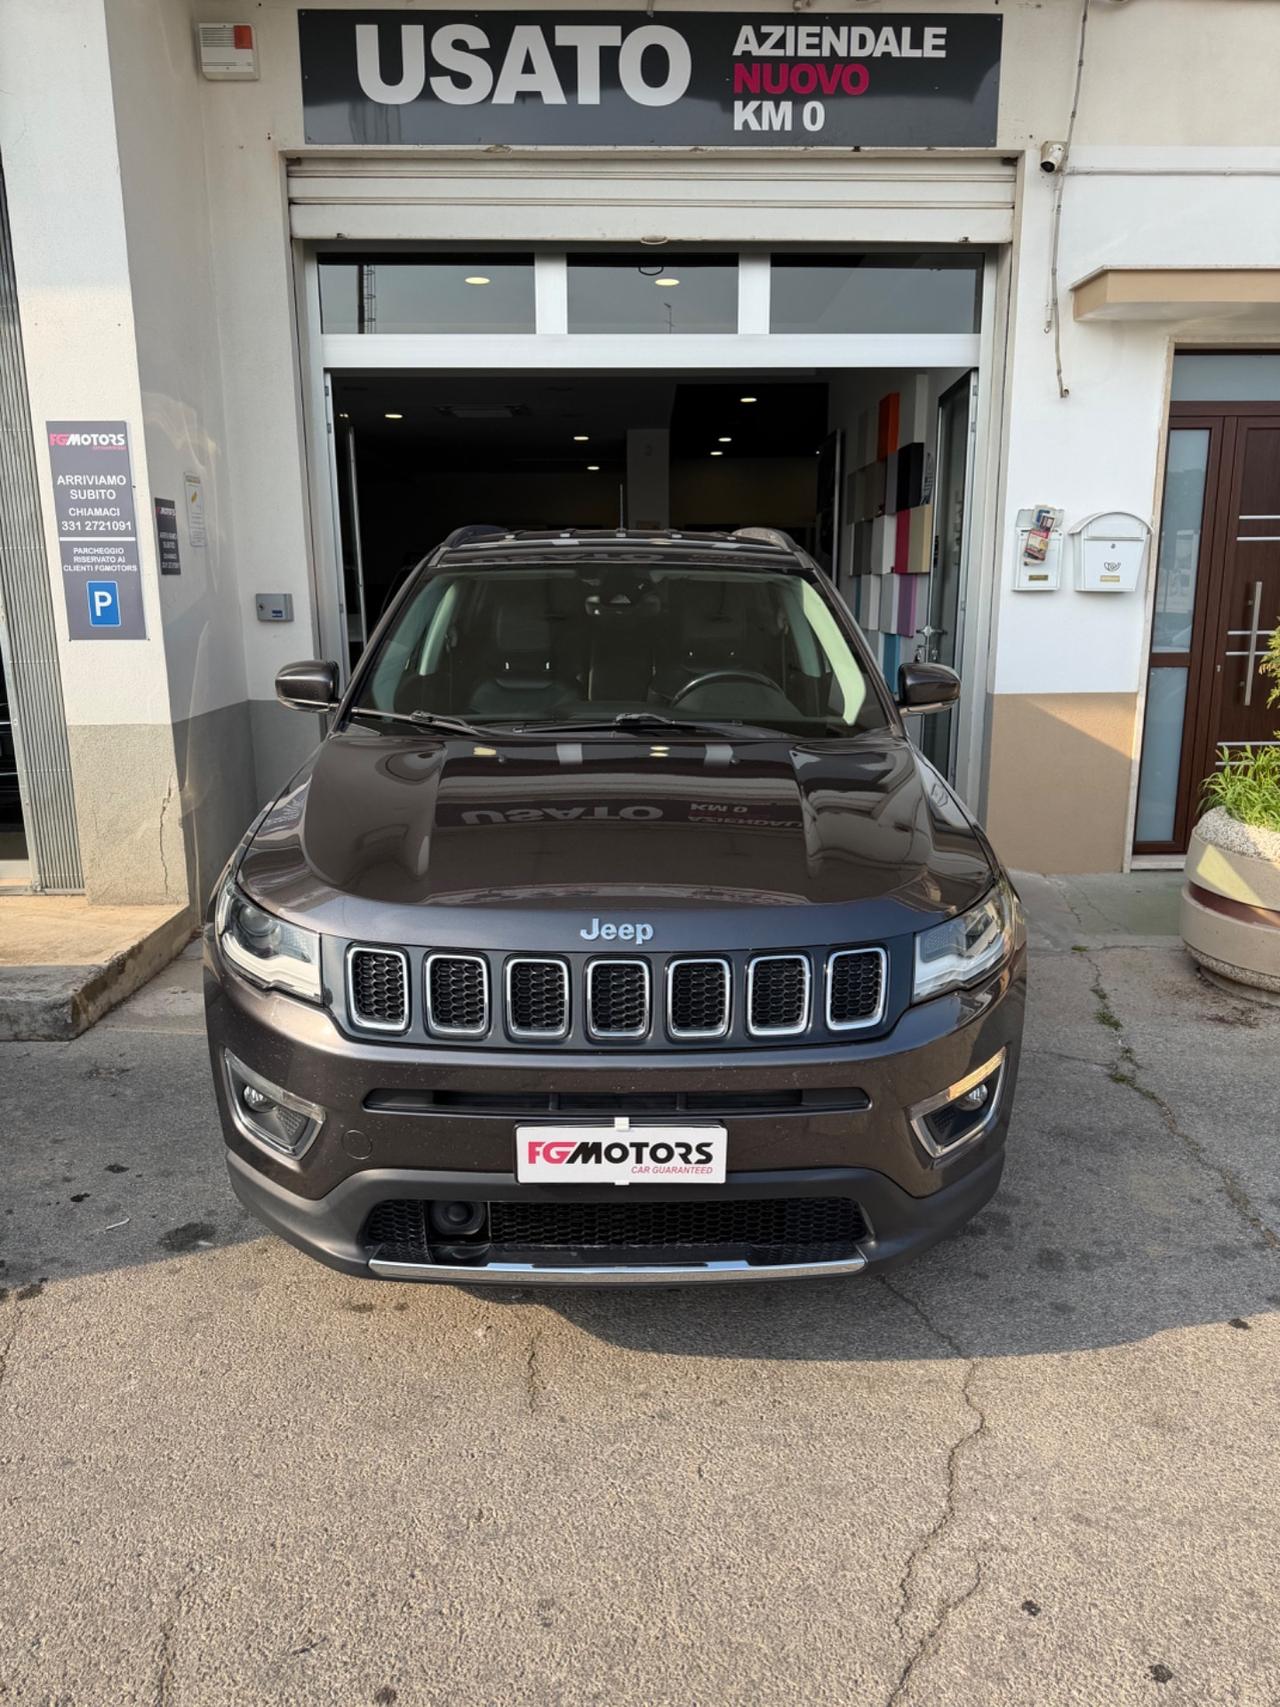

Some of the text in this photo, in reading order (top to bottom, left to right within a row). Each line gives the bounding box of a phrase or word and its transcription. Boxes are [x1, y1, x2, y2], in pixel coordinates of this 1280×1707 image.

[733, 26, 947, 58] AZIENDALE
[355, 25, 692, 107] USATO
[733, 63, 870, 95] NUOVO
[733, 101, 825, 132] KM 0
[49, 433, 126, 446] FGMOTORS
[57, 475, 127, 486] ARRIVIAMO
[70, 489, 117, 501] SUBITO
[68, 507, 120, 517] CHIAMACI
[61, 521, 132, 531] 331 2721091
[73, 547, 125, 555] PARCHEGGIO
[73, 555, 116, 563] RISERVATO
[94, 591, 112, 617] P
[580, 918, 654, 944] Jeep
[528, 1141, 714, 1165] FGMOTORS
[631, 1166, 713, 1174] CAR GUARANTEED
